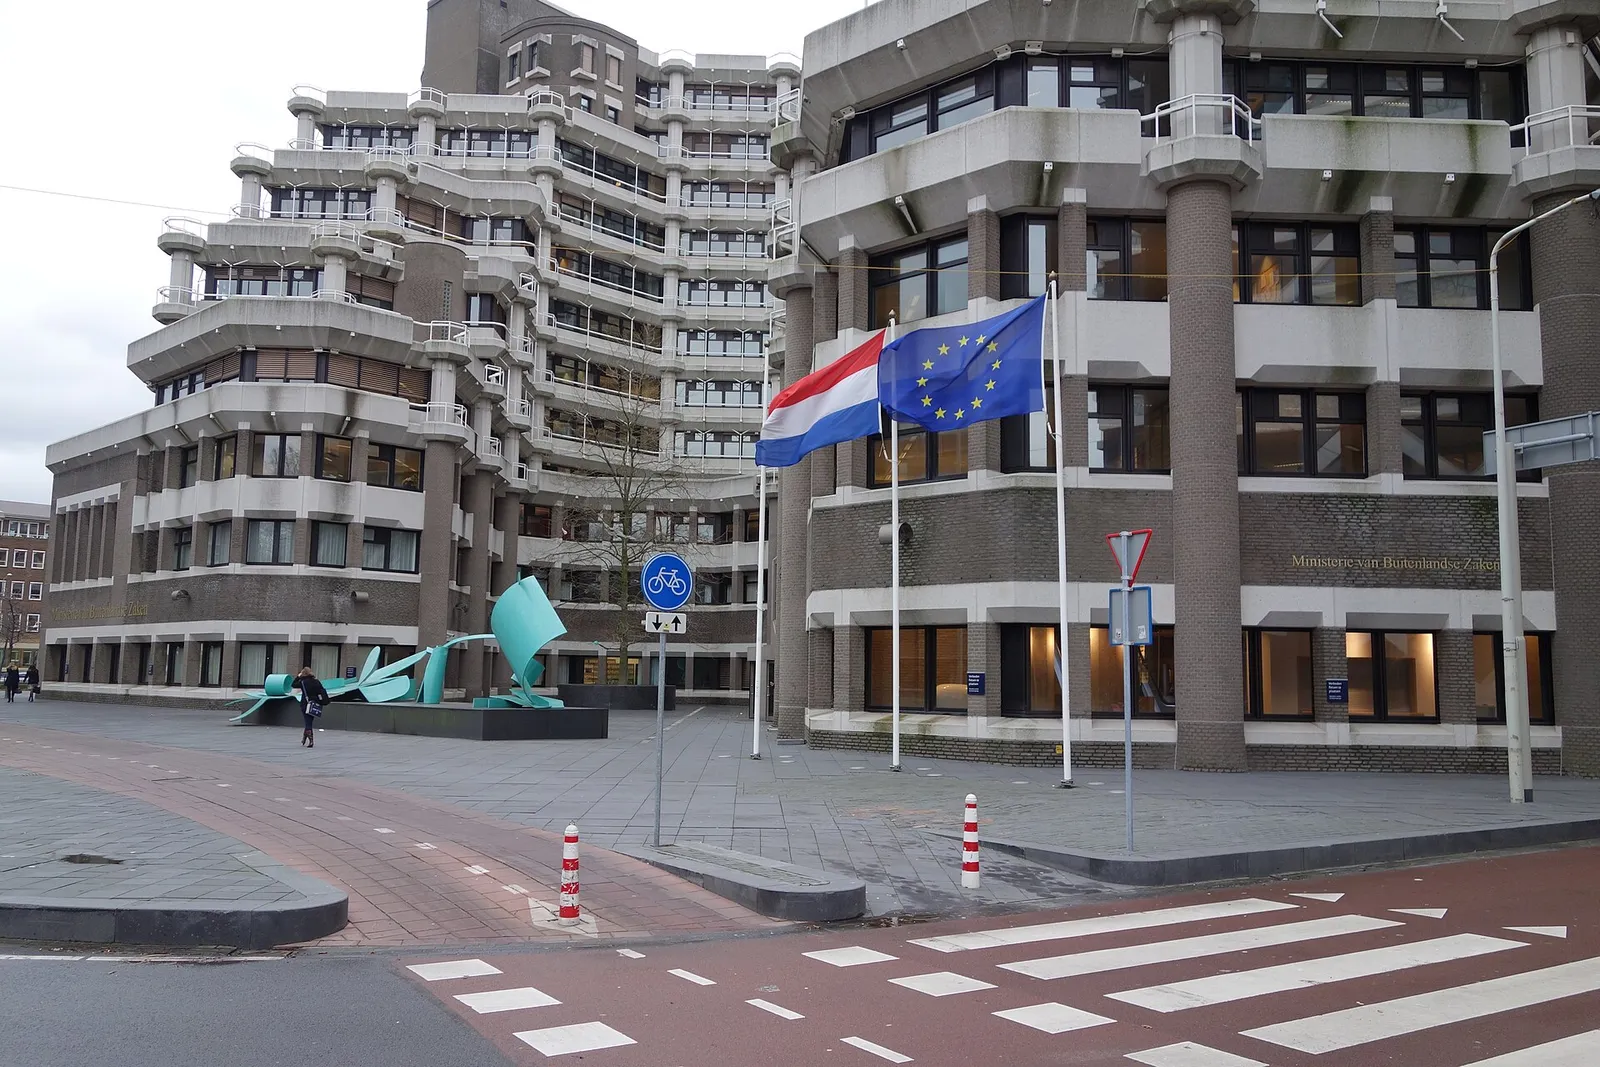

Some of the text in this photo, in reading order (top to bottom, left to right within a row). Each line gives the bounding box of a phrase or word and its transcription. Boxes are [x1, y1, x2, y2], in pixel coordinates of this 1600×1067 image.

[1292, 554, 1500, 570] Ministerie van Buitenlandse Zaken
